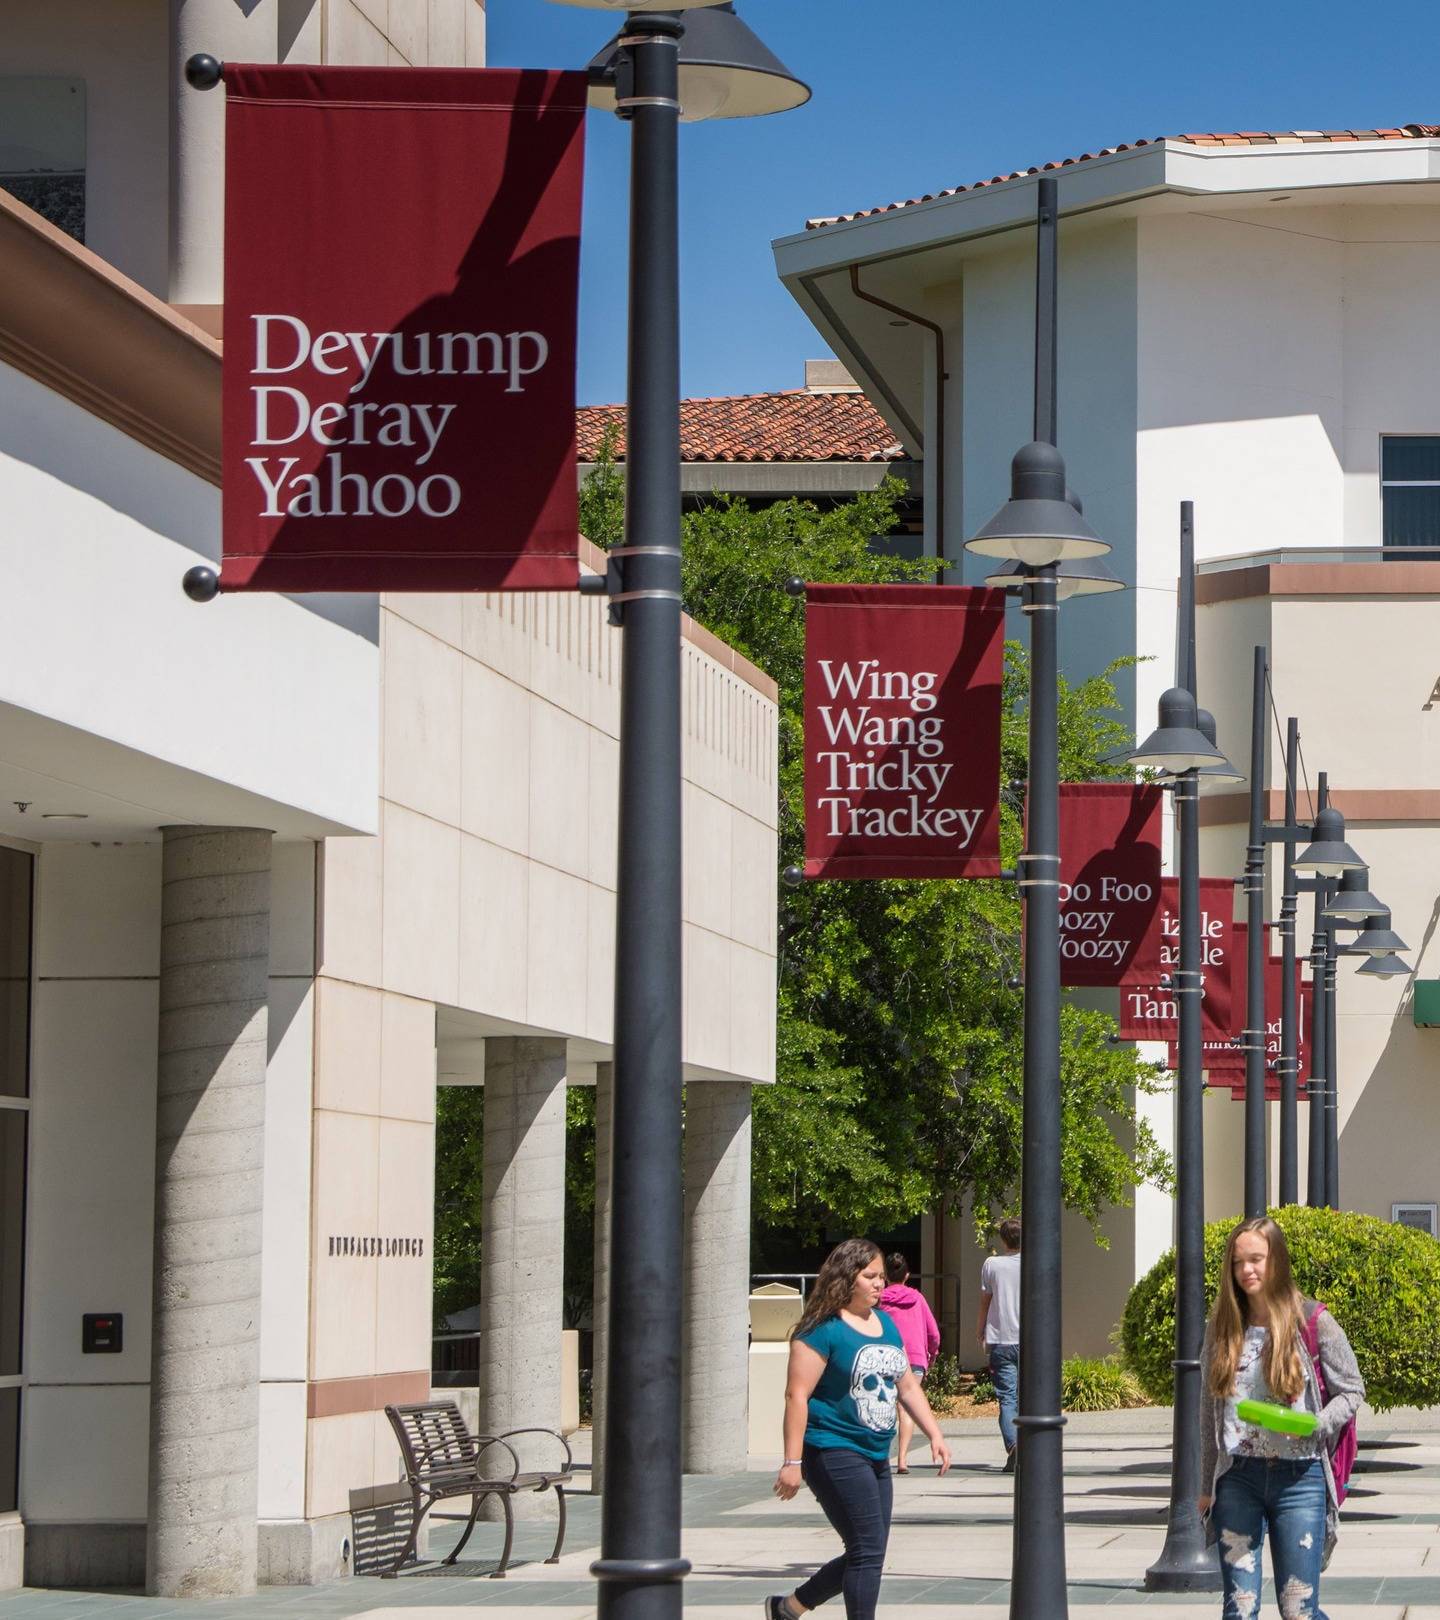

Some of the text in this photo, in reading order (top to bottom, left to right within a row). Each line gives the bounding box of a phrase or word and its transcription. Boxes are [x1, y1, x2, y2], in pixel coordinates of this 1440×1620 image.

[249, 314, 548, 392] Deyump
[249, 386, 456, 465] Deray
[244, 452, 461, 518] Yahoo
[817, 659, 938, 712] Wing
[817, 705, 944, 757] Wang
[817, 749, 953, 803] Tricky
[817, 795, 984, 849] Trackey
[1059, 877, 1152, 902] oo Foo
[1059, 934, 1131, 966] oozy
[1128, 993, 1180, 1019] Tan
[329, 1237, 424, 1257] HUNSAKER LOUNGE
